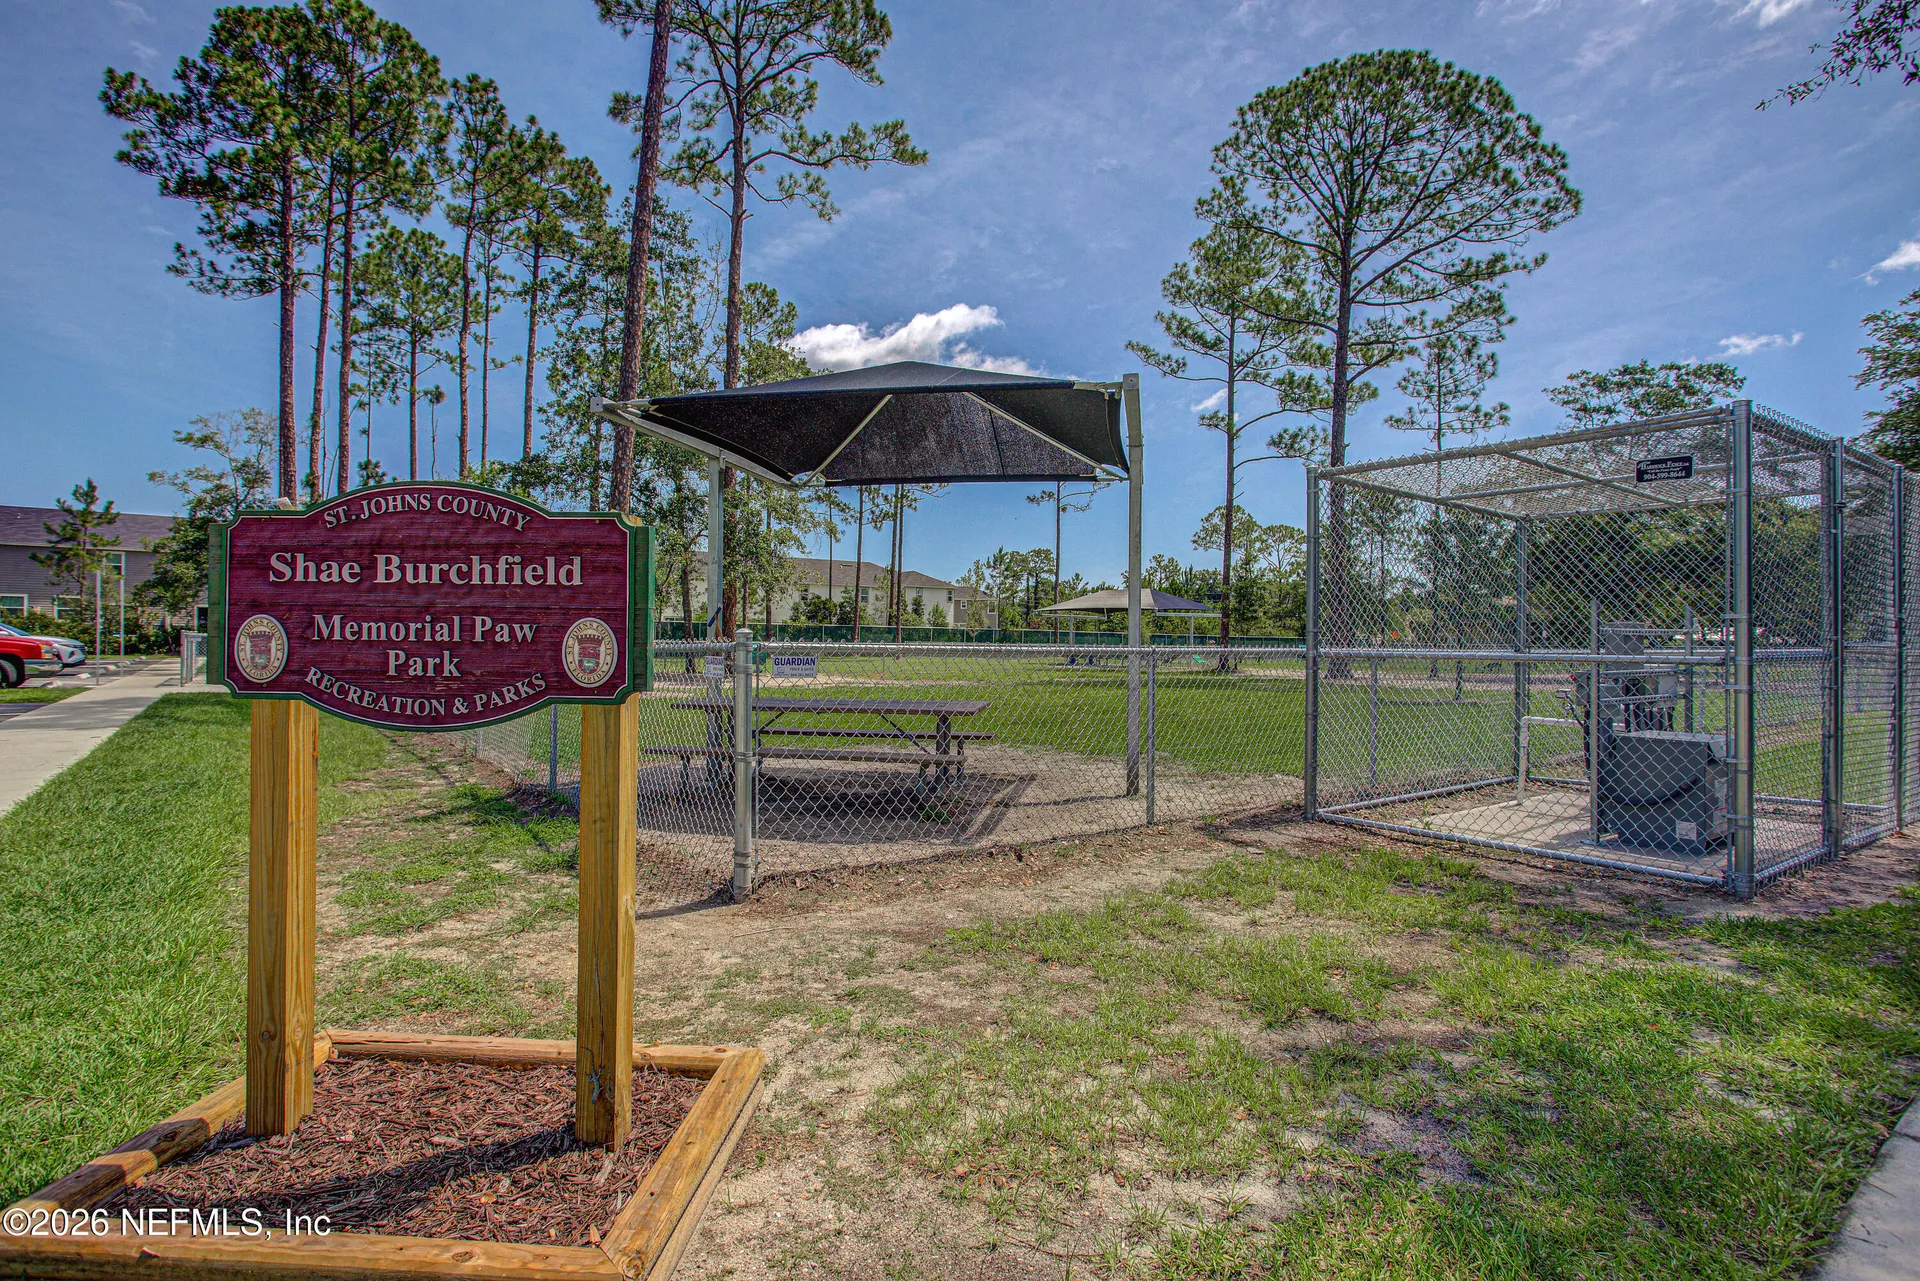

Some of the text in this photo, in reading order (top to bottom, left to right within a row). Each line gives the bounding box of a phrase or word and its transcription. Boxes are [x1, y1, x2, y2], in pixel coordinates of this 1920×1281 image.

[323, 493, 531, 532] ST. JOHNS COUNTY
[269, 552, 583, 586] Shae Burchfield
[242, 619, 264, 638] JOHNS
[266, 621, 283, 653] COUNTY
[312, 614, 538, 643] Memorial Paw
[571, 622, 594, 640] JOHNS
[596, 624, 612, 657] COUNTY
[245, 665, 278, 678] FLORIDA
[386, 650, 461, 677] Park
[572, 668, 606, 682] FLORIDA
[774, 657, 816, 666] GUARDIAN
[304, 666, 547, 716] RECREATION & PARKS
